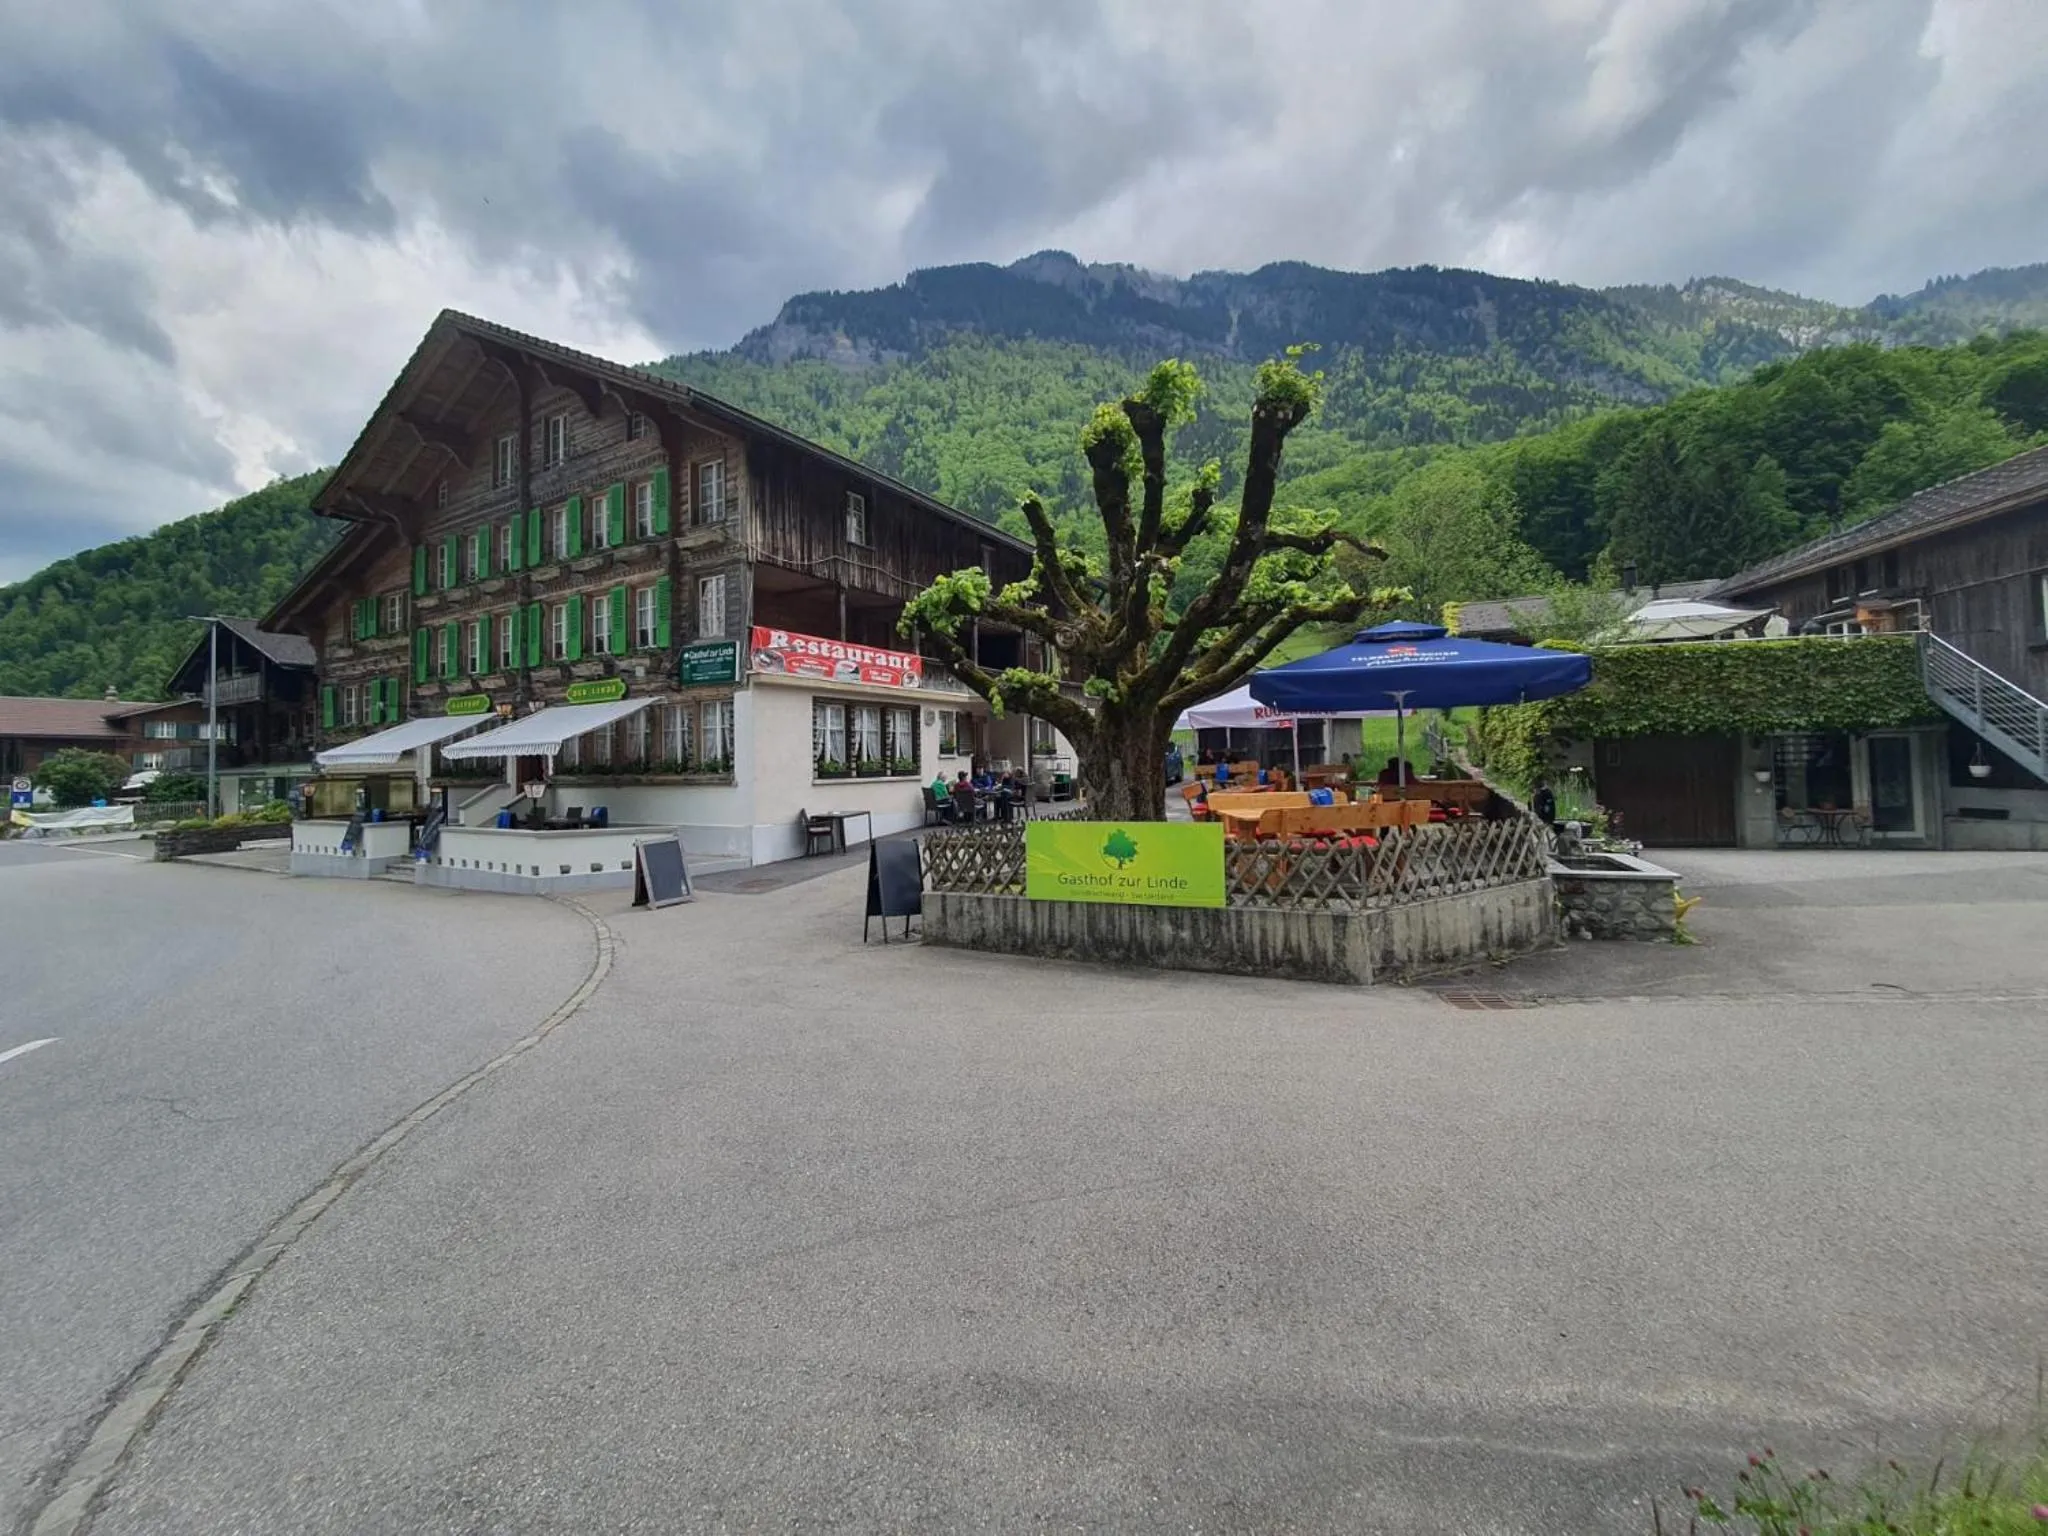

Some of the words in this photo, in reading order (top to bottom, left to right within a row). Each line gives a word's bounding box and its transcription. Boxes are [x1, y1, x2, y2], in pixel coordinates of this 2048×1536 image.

[767, 630, 912, 671] Restaurant
[1057, 872, 1113, 886] Gasthof
[1119, 876, 1140, 887] zur
[1147, 875, 1188, 890] Linde
